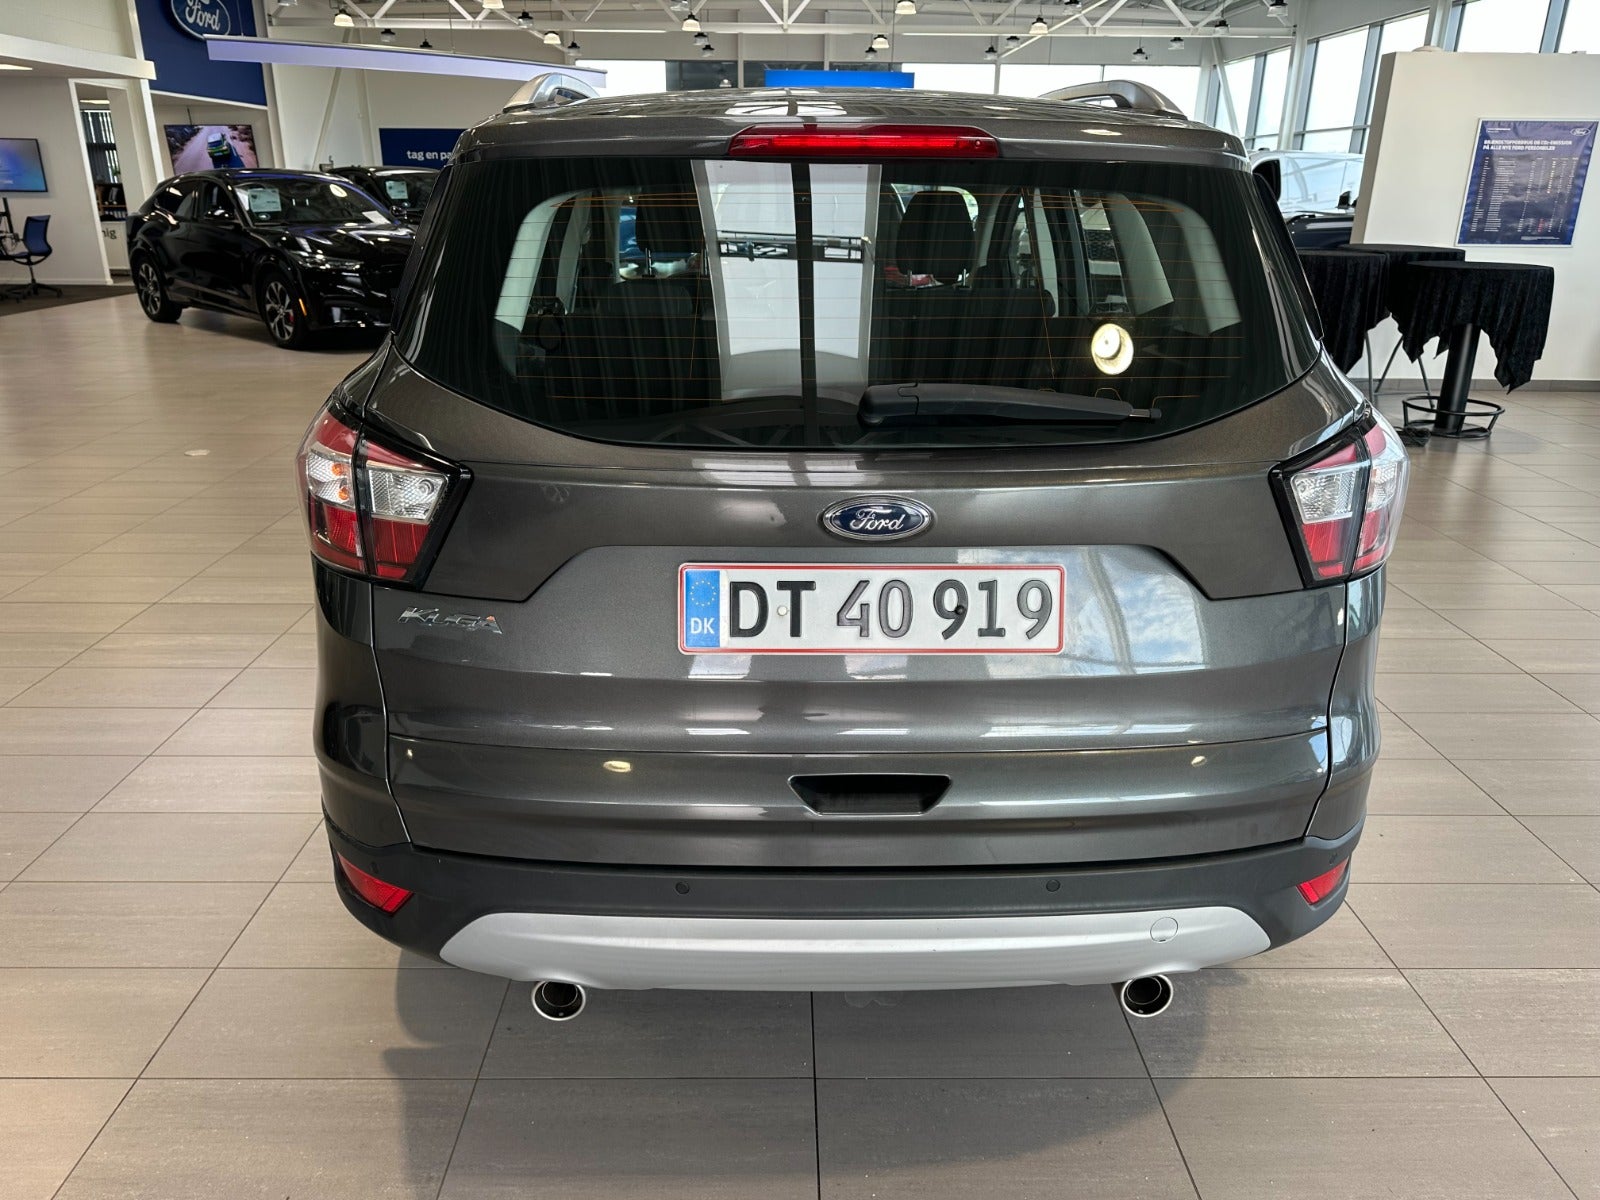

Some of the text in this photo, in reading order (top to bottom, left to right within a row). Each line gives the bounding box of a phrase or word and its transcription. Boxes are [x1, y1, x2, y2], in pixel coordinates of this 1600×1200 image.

[185, 0, 220, 31] Ford
[406, 150, 424, 161] tag
[425, 151, 438, 160] en
[849, 507, 905, 532] Ford
[729, 579, 1053, 640] DT 40 919
[690, 617, 715, 634] DK
